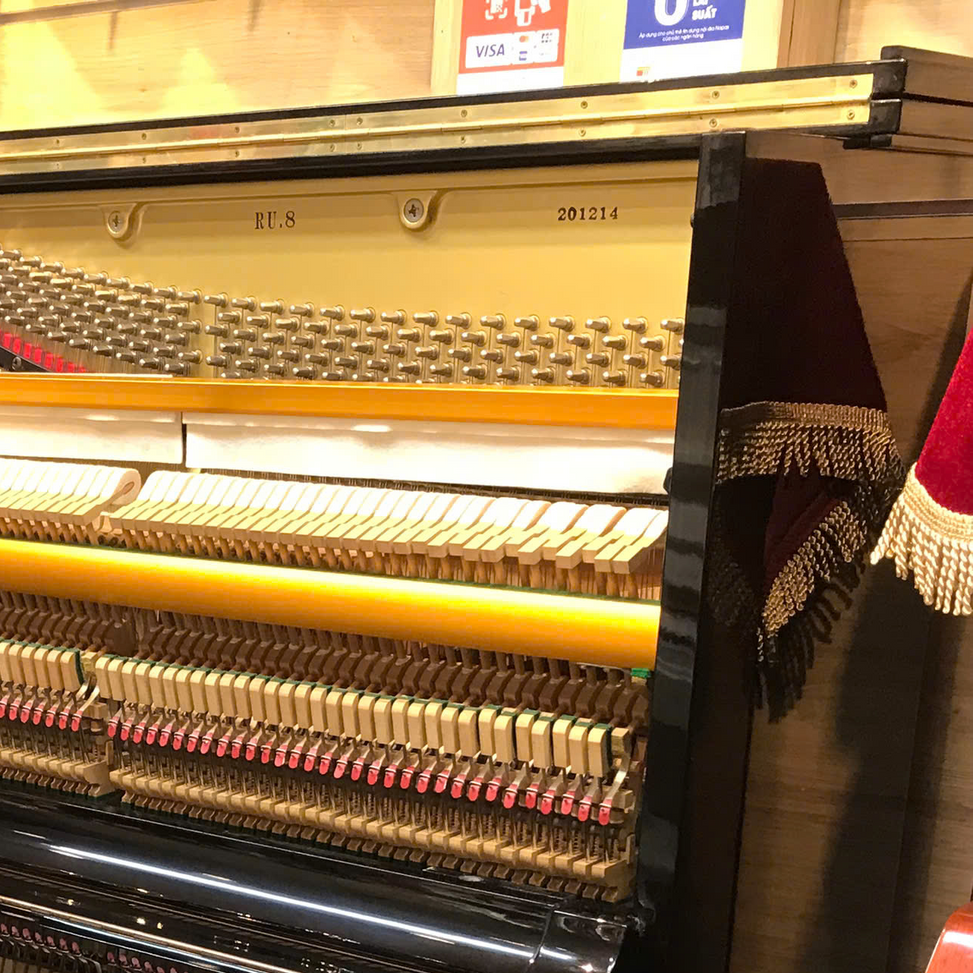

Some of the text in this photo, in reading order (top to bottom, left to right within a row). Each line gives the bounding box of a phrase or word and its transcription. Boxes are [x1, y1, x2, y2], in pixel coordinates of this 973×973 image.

[476, 43, 505, 58] VISA
[254, 210, 296, 230] RU.8
[557, 206, 619, 222] 201214
